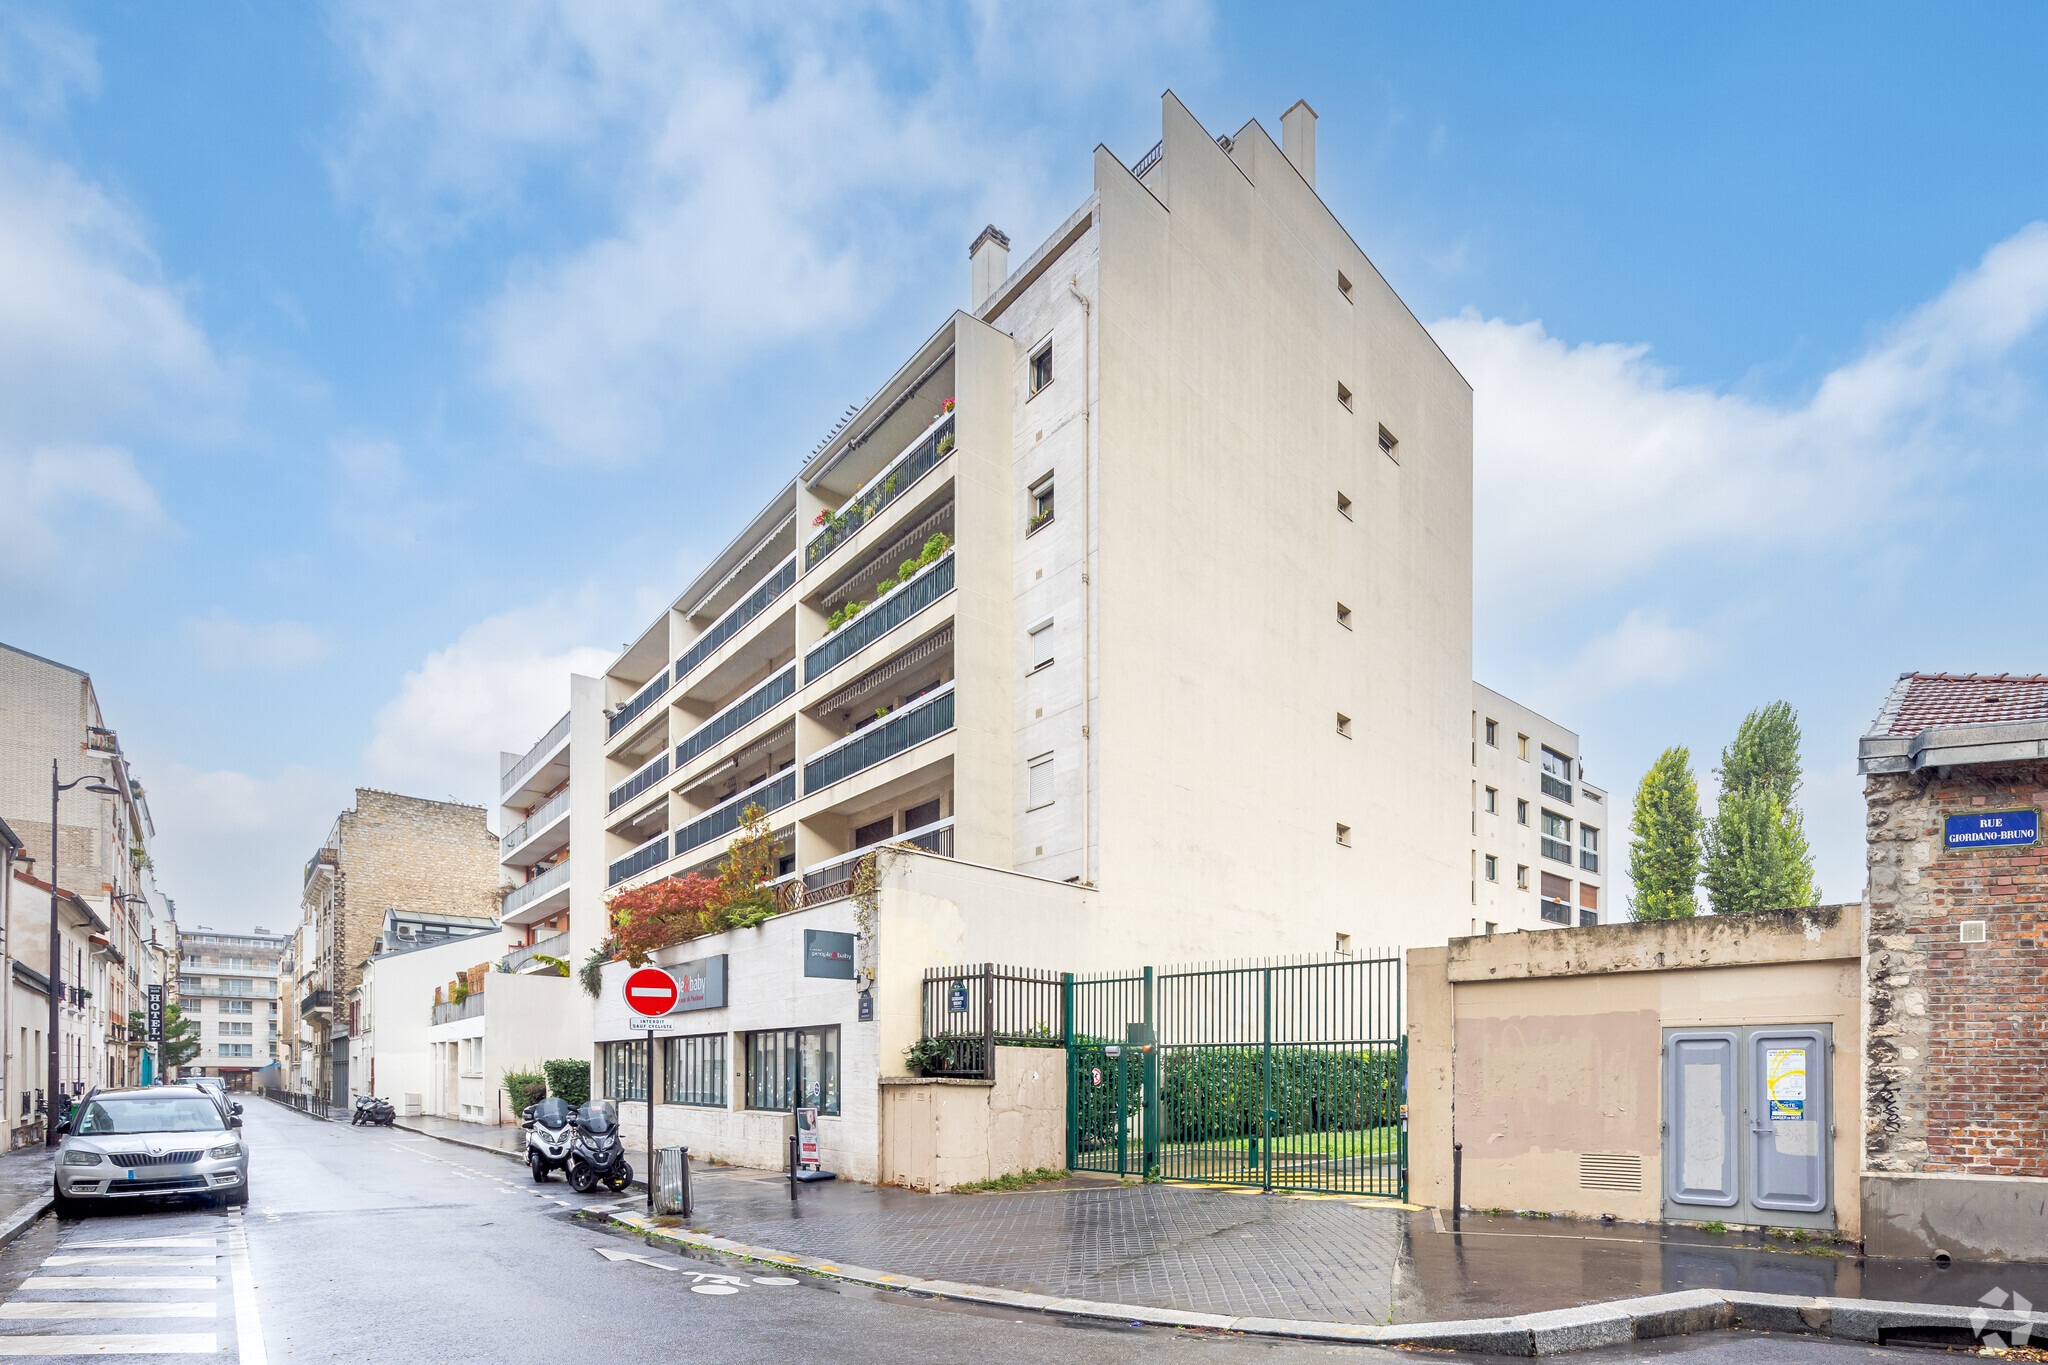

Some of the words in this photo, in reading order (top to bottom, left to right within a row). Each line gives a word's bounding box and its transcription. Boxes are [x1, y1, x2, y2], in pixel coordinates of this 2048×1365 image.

[1980, 818, 2003, 828] RUE
[1949, 829, 2035, 843] GIORDANO-BRUNO
[150, 994, 161, 1036] HOTEL
